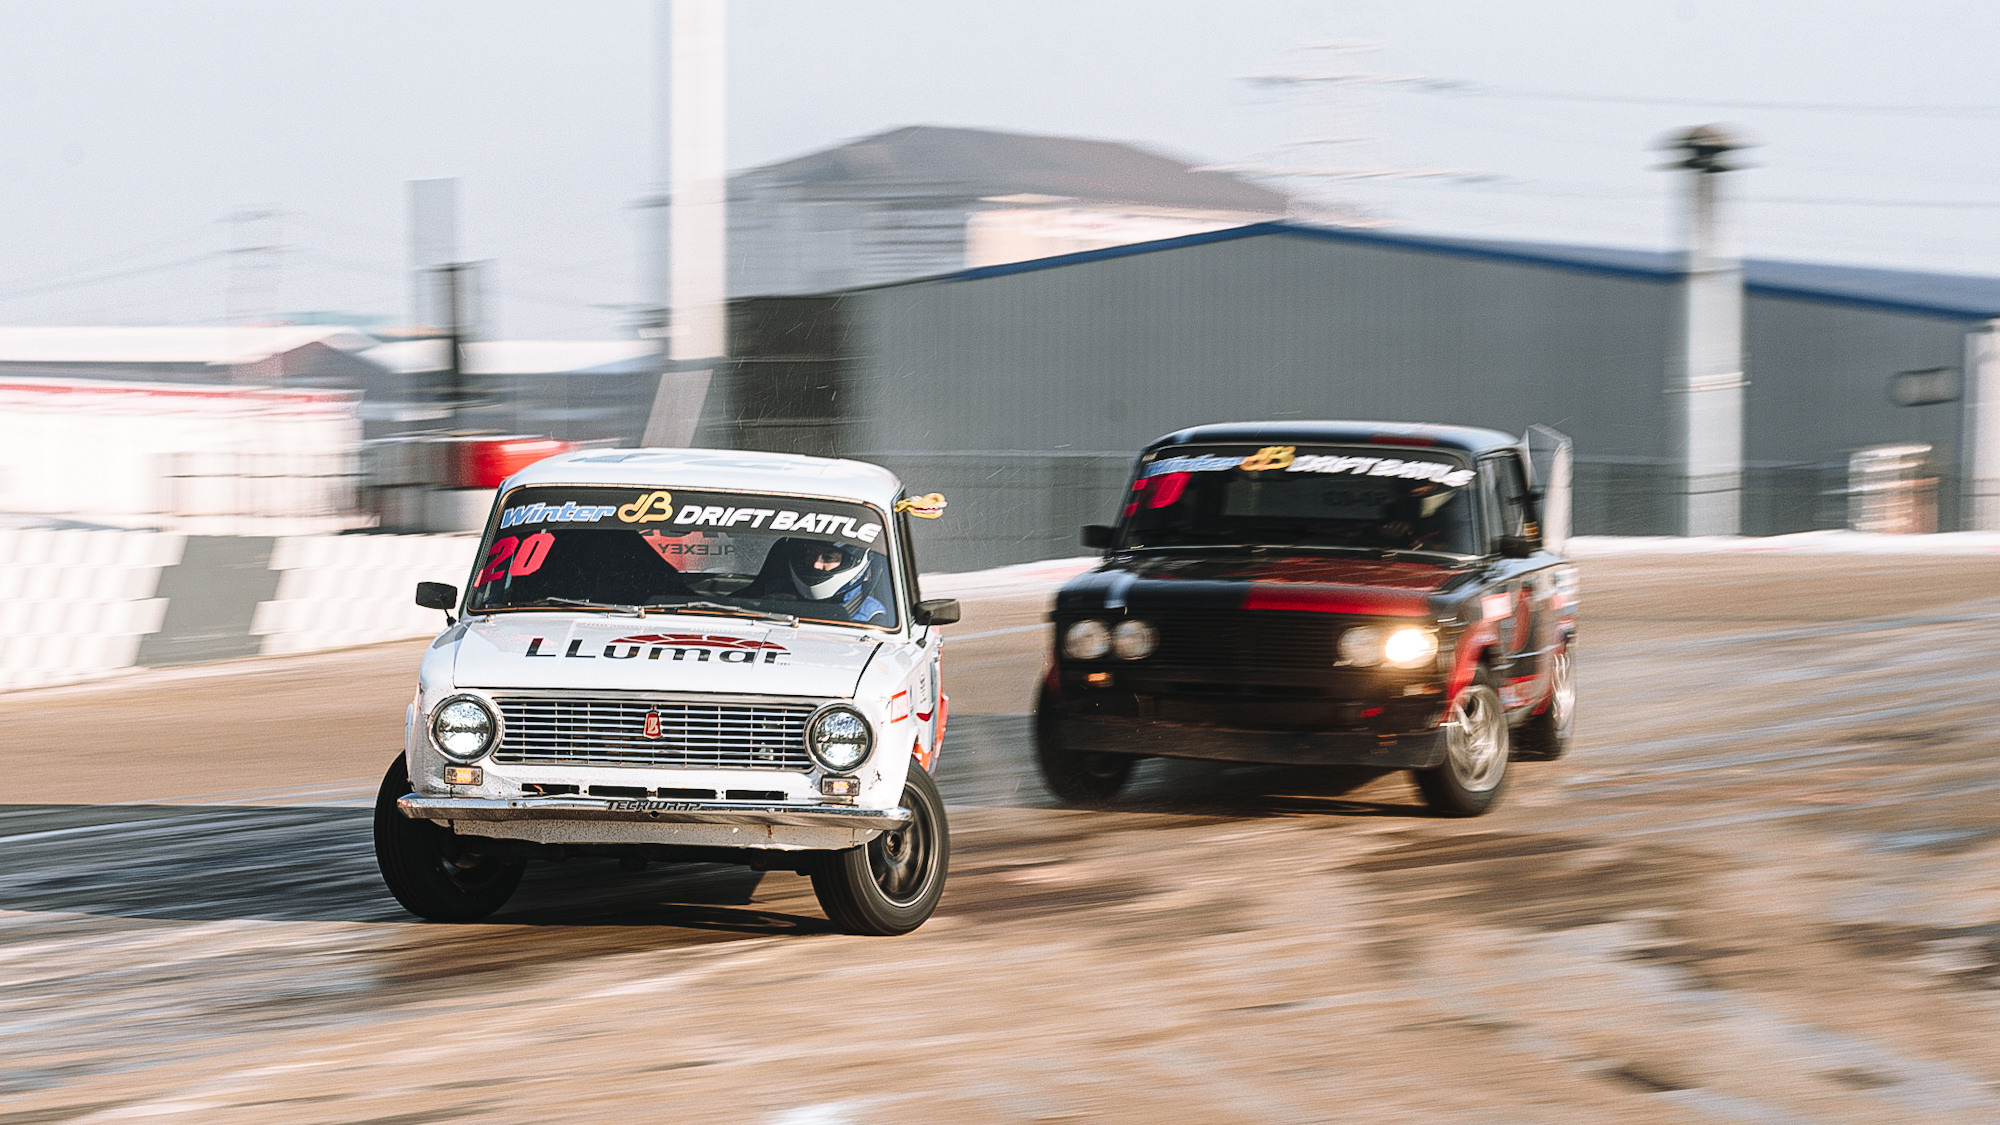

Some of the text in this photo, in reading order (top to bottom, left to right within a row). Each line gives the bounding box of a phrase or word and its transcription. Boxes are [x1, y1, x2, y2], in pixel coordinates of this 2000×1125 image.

[500, 501, 617, 530] Winter
[673, 505, 775, 529] DRIFT
[768, 510, 883, 544] BATTLE
[474, 531, 556, 588] 20
[524, 637, 791, 665] LLumar
